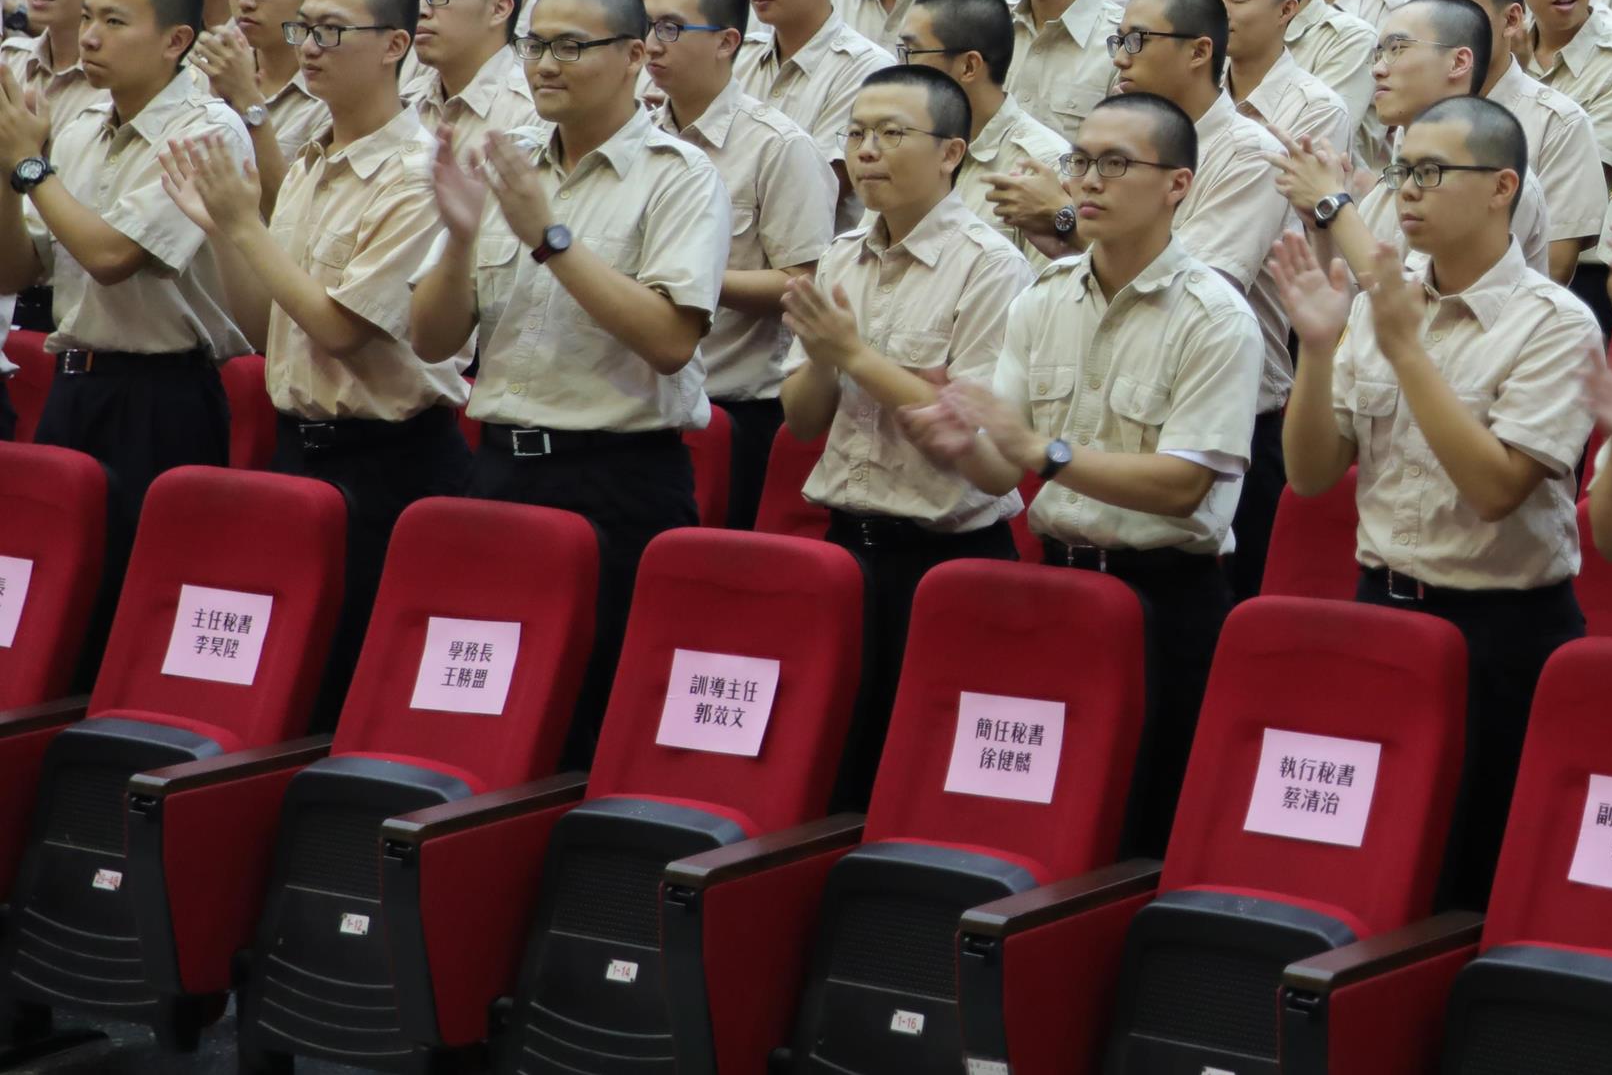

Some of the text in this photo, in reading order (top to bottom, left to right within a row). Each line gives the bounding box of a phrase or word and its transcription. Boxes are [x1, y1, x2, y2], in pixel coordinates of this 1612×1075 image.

[191, 608, 253, 634] 主任秘書
[448, 640, 494, 662] 學務長
[440, 666, 489, 689] 王勝盟
[689, 673, 759, 703] 訓導主任
[693, 702, 746, 729] 郭效文
[975, 717, 1045, 746] 簡任秘書
[1279, 755, 1356, 787] 執行秘書
[1281, 786, 1340, 816] 蔡清治
